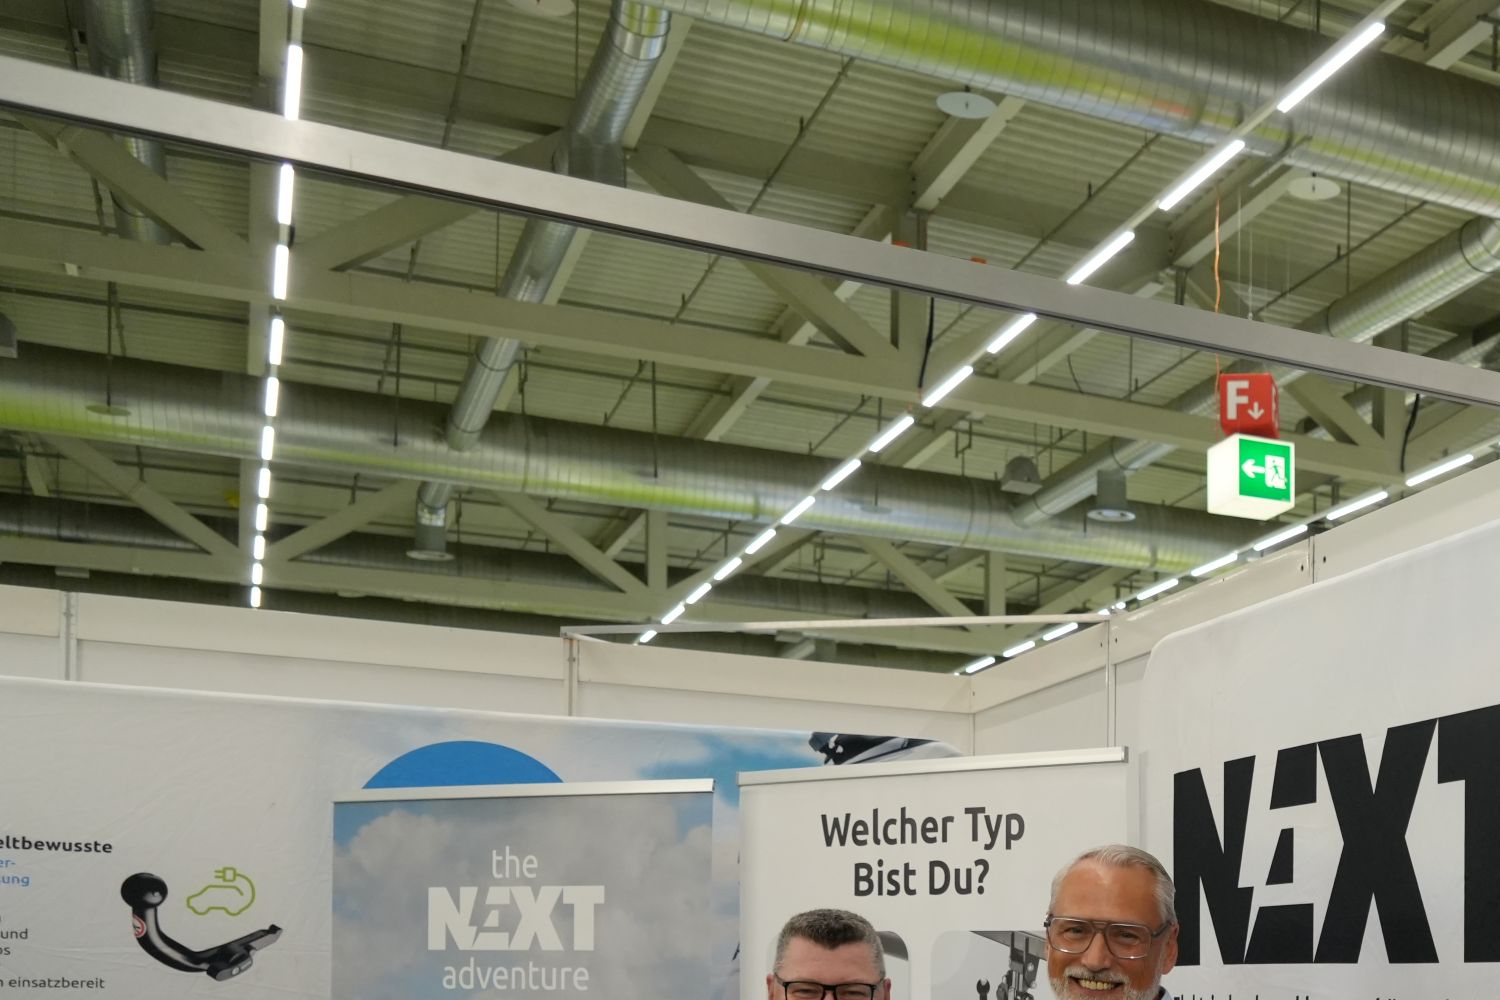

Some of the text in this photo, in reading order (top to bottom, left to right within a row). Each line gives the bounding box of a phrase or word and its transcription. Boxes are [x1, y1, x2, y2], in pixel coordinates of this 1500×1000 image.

[1226, 380, 1249, 420] F
[821, 806, 1025, 851] Welcher Typ
[491, 845, 538, 879] the
[854, 859, 990, 897] Bist Du?
[428, 885, 605, 951] NEXT
[8, 976, 105, 989] einsatzbereit
[442, 957, 590, 991] adventure
